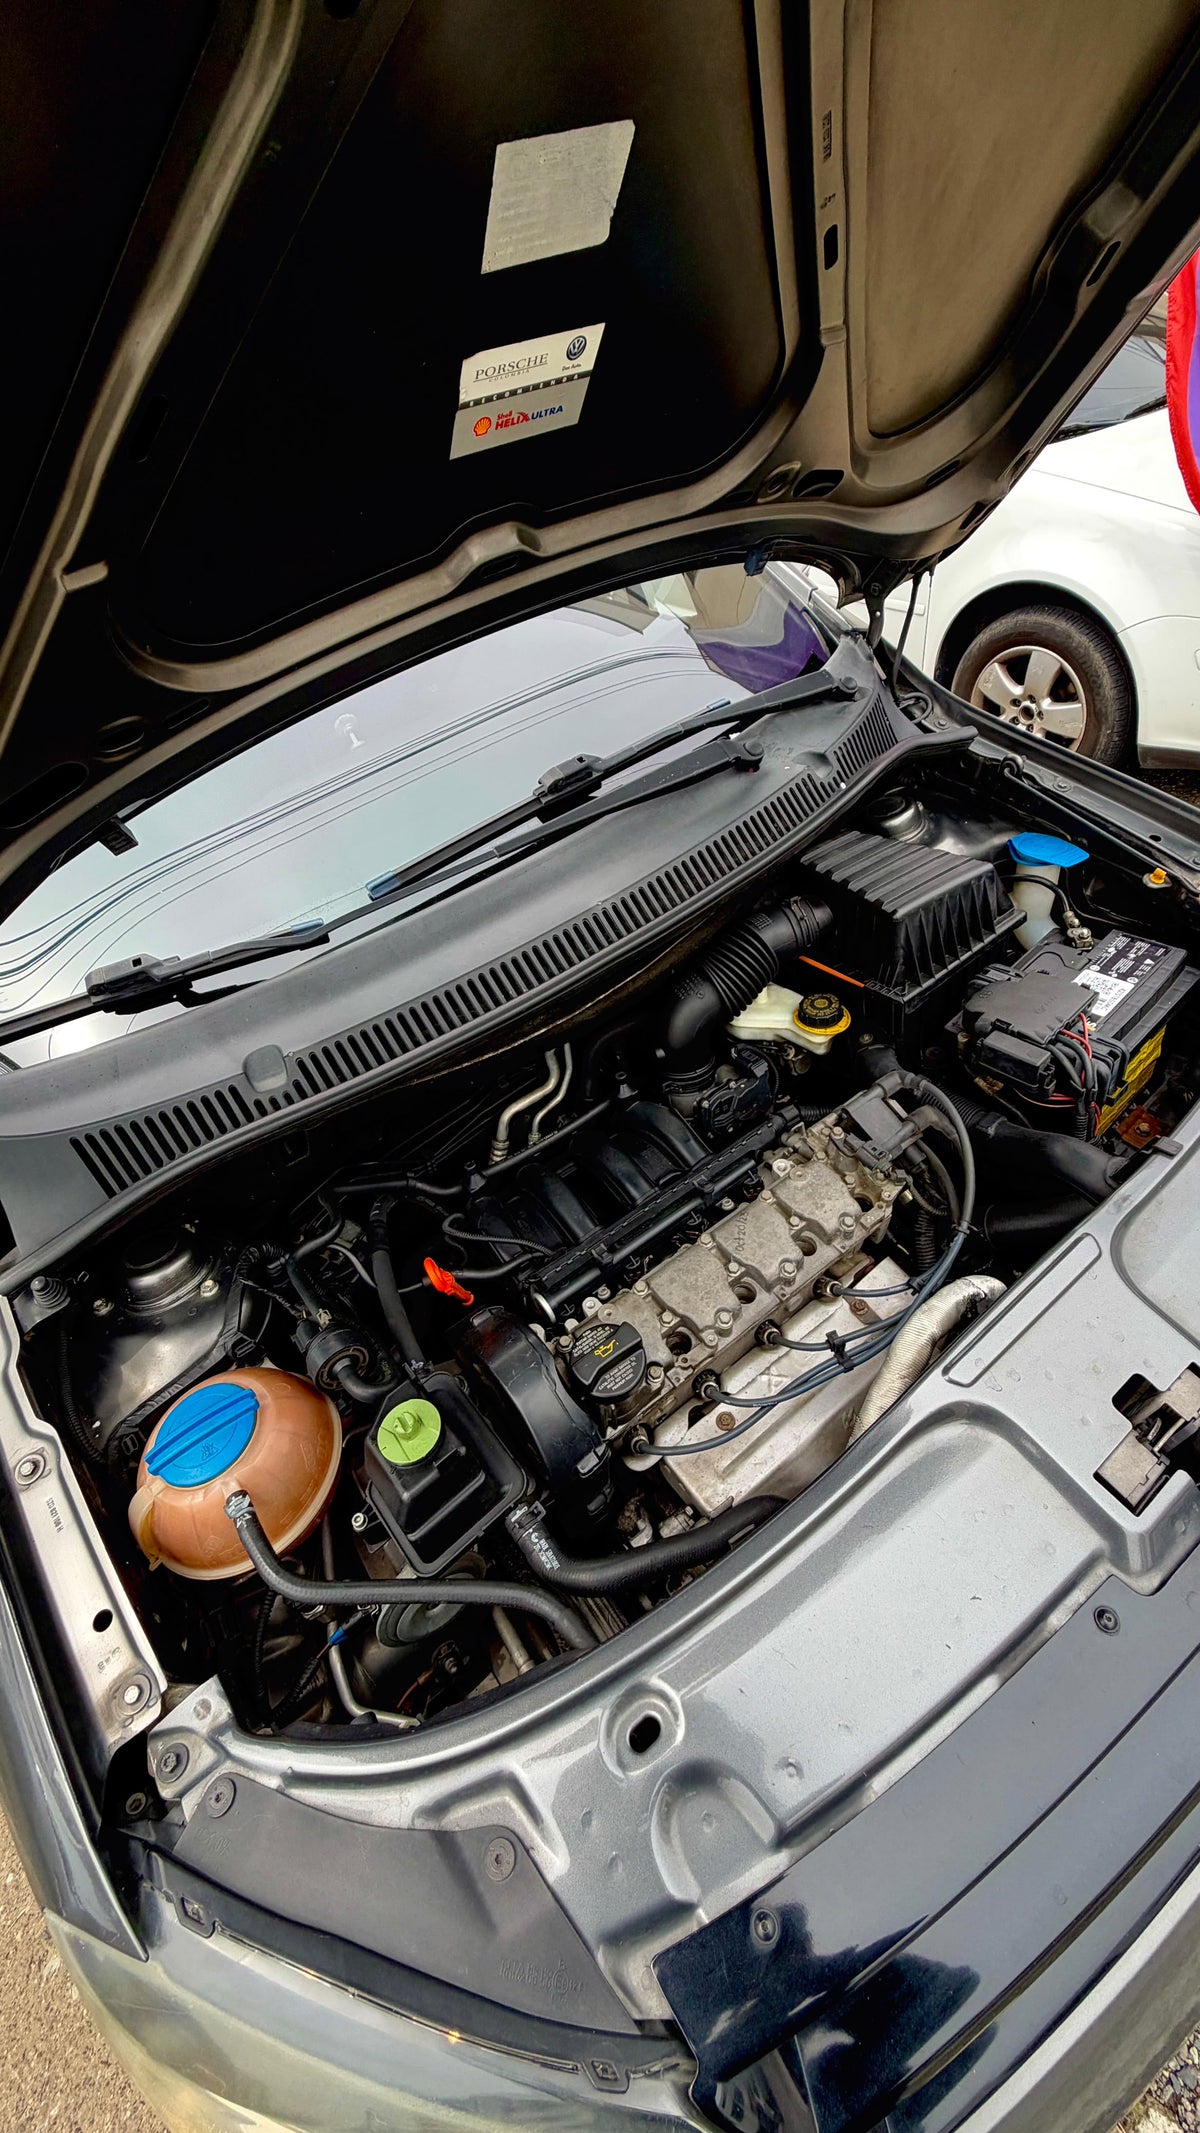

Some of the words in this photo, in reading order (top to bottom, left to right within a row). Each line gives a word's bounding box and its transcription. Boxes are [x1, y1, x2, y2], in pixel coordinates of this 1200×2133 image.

[474, 353, 549, 380] PORSCHE
[488, 369, 530, 382] COLOMBIA
[469, 374, 578, 407] RECOMIENDA
[495, 412, 531, 430] HELIX
[531, 405, 564, 420] ULTRA
[496, 410, 513, 420] Shell
